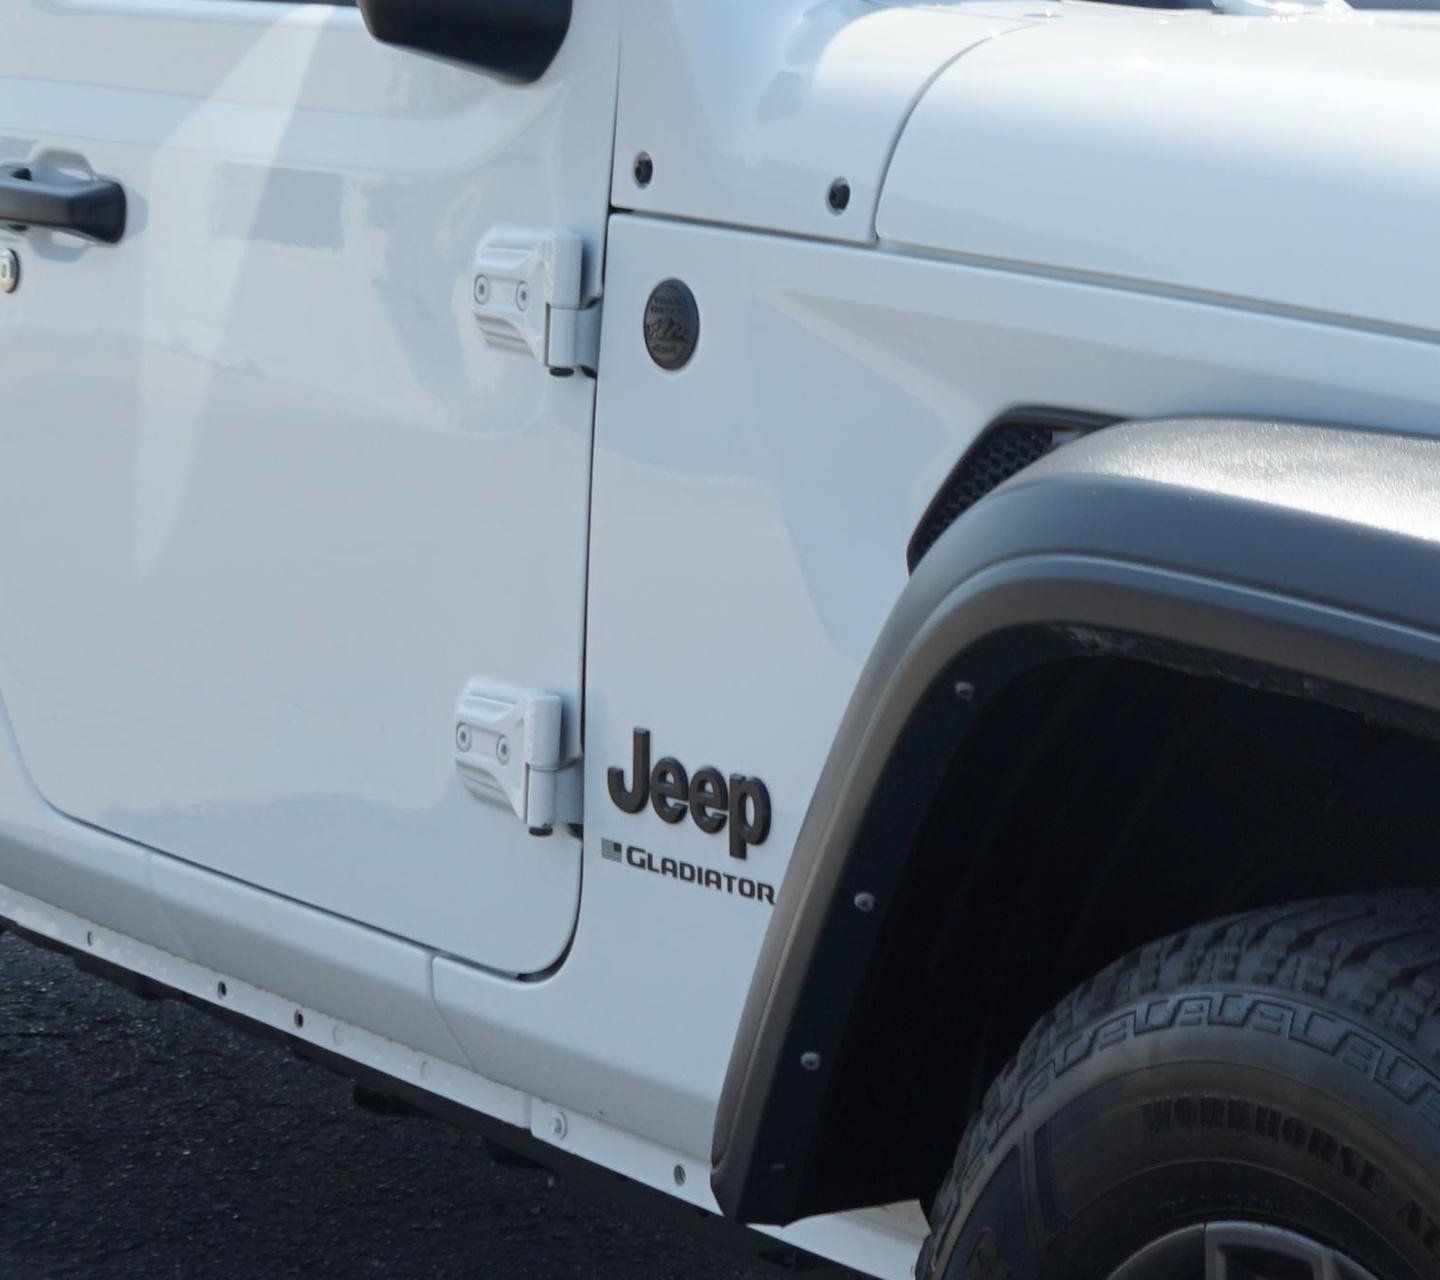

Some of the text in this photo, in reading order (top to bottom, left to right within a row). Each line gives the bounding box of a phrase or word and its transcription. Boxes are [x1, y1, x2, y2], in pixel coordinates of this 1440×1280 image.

[607, 727, 772, 859] Jeep
[626, 847, 775, 905] GLADIATOR
[1140, 1091, 1388, 1195] WORKHORSE
